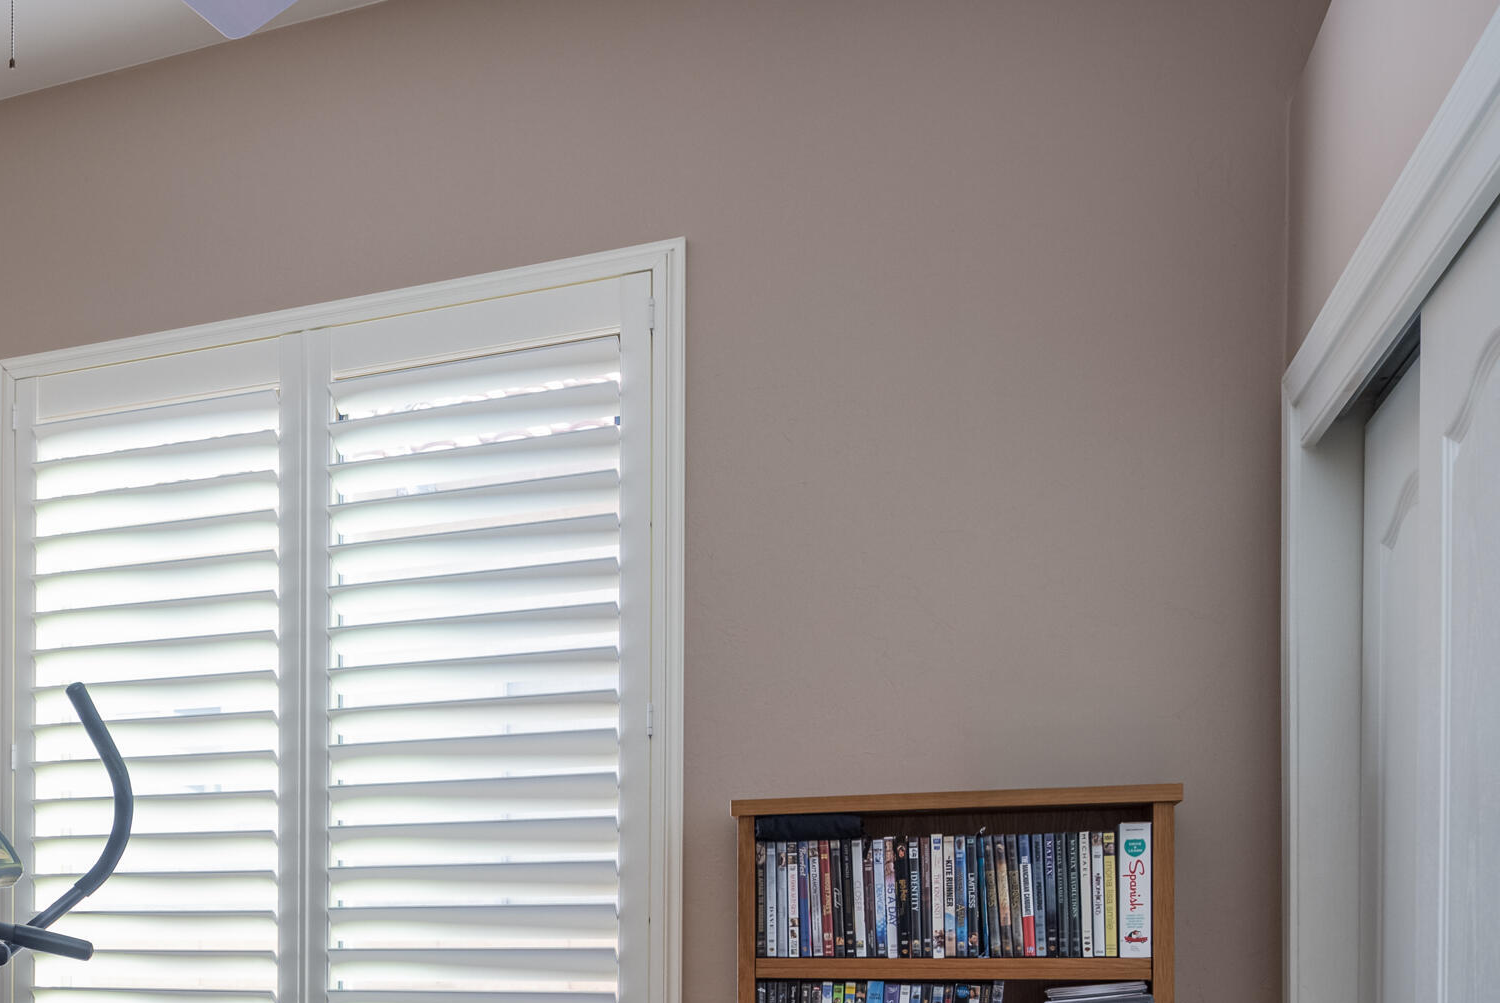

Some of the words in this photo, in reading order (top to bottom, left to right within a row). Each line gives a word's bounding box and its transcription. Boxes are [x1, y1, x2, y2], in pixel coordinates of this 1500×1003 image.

[911, 870, 920, 912] IDENTITY
[946, 877, 954, 907] RUNNER
[968, 872, 976, 909] LIMITLESS
[1107, 889, 1115, 905] lisa
[1122, 859, 1145, 912] Spanish
[887, 896, 895, 907] A
[888, 907, 897, 928] DAY
